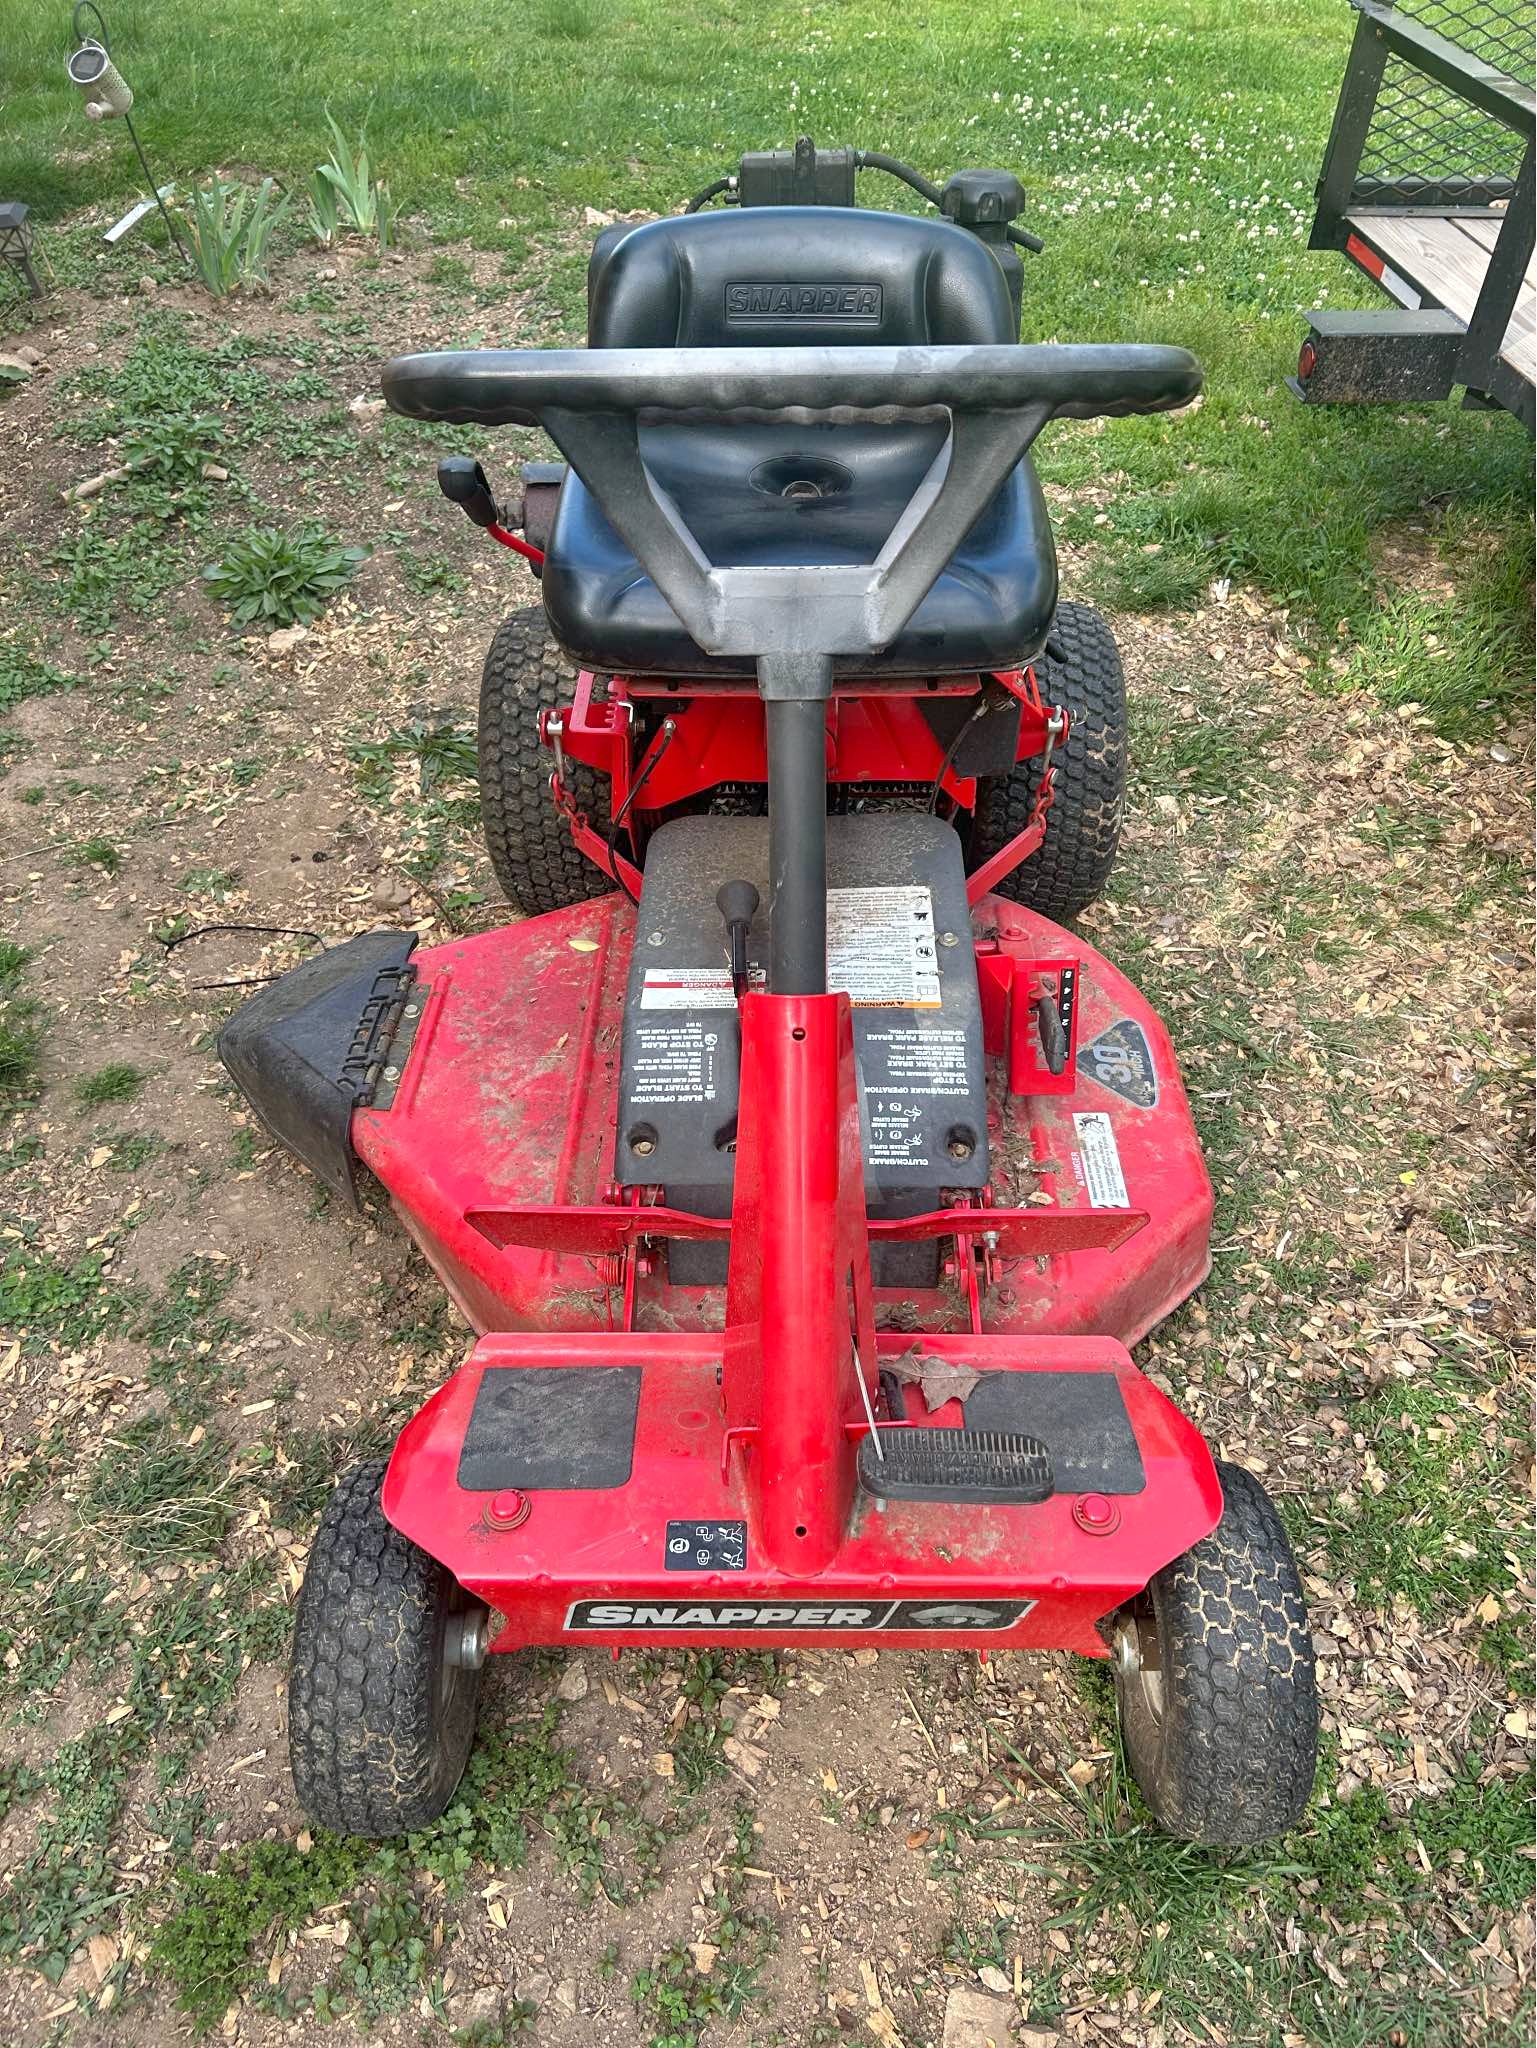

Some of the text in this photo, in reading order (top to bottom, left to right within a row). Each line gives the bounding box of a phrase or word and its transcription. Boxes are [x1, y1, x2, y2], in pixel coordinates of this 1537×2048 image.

[729, 287, 878, 313] SNAPPER
[1063, 1003, 1070, 1011] 3
[1062, 1018, 1069, 1026] 2
[1093, 1046, 1131, 1084] 30
[910, 1087, 969, 1095] CLUTCH/BRAKE
[1070, 1151, 1084, 1180] DANGER
[586, 1606, 873, 1625] SNAPPER
